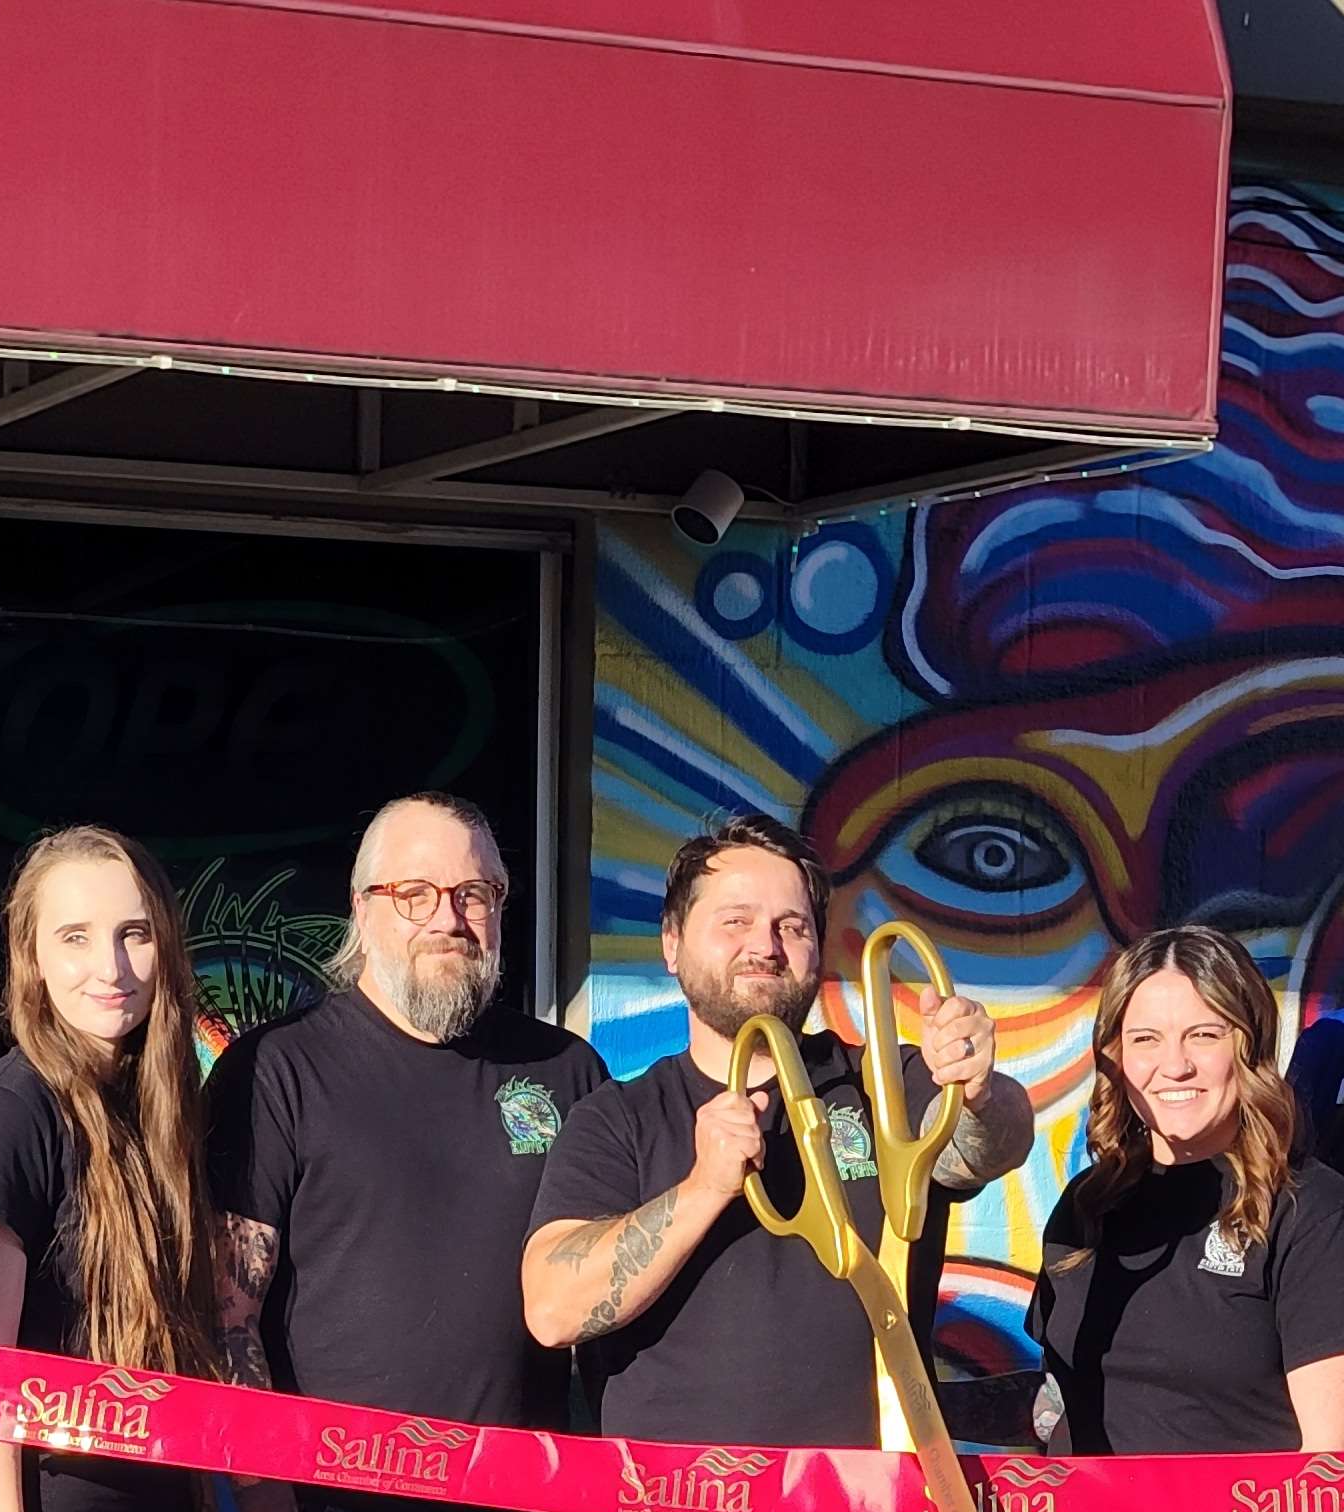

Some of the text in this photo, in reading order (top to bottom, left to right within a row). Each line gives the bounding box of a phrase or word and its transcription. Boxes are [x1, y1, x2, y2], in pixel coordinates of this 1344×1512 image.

[19, 1377, 150, 1440] Salina
[314, 1469, 335, 1482] Area
[337, 1471, 380, 1488] Chamber
[383, 1477, 396, 1491] of
[316, 1426, 449, 1482] Salina
